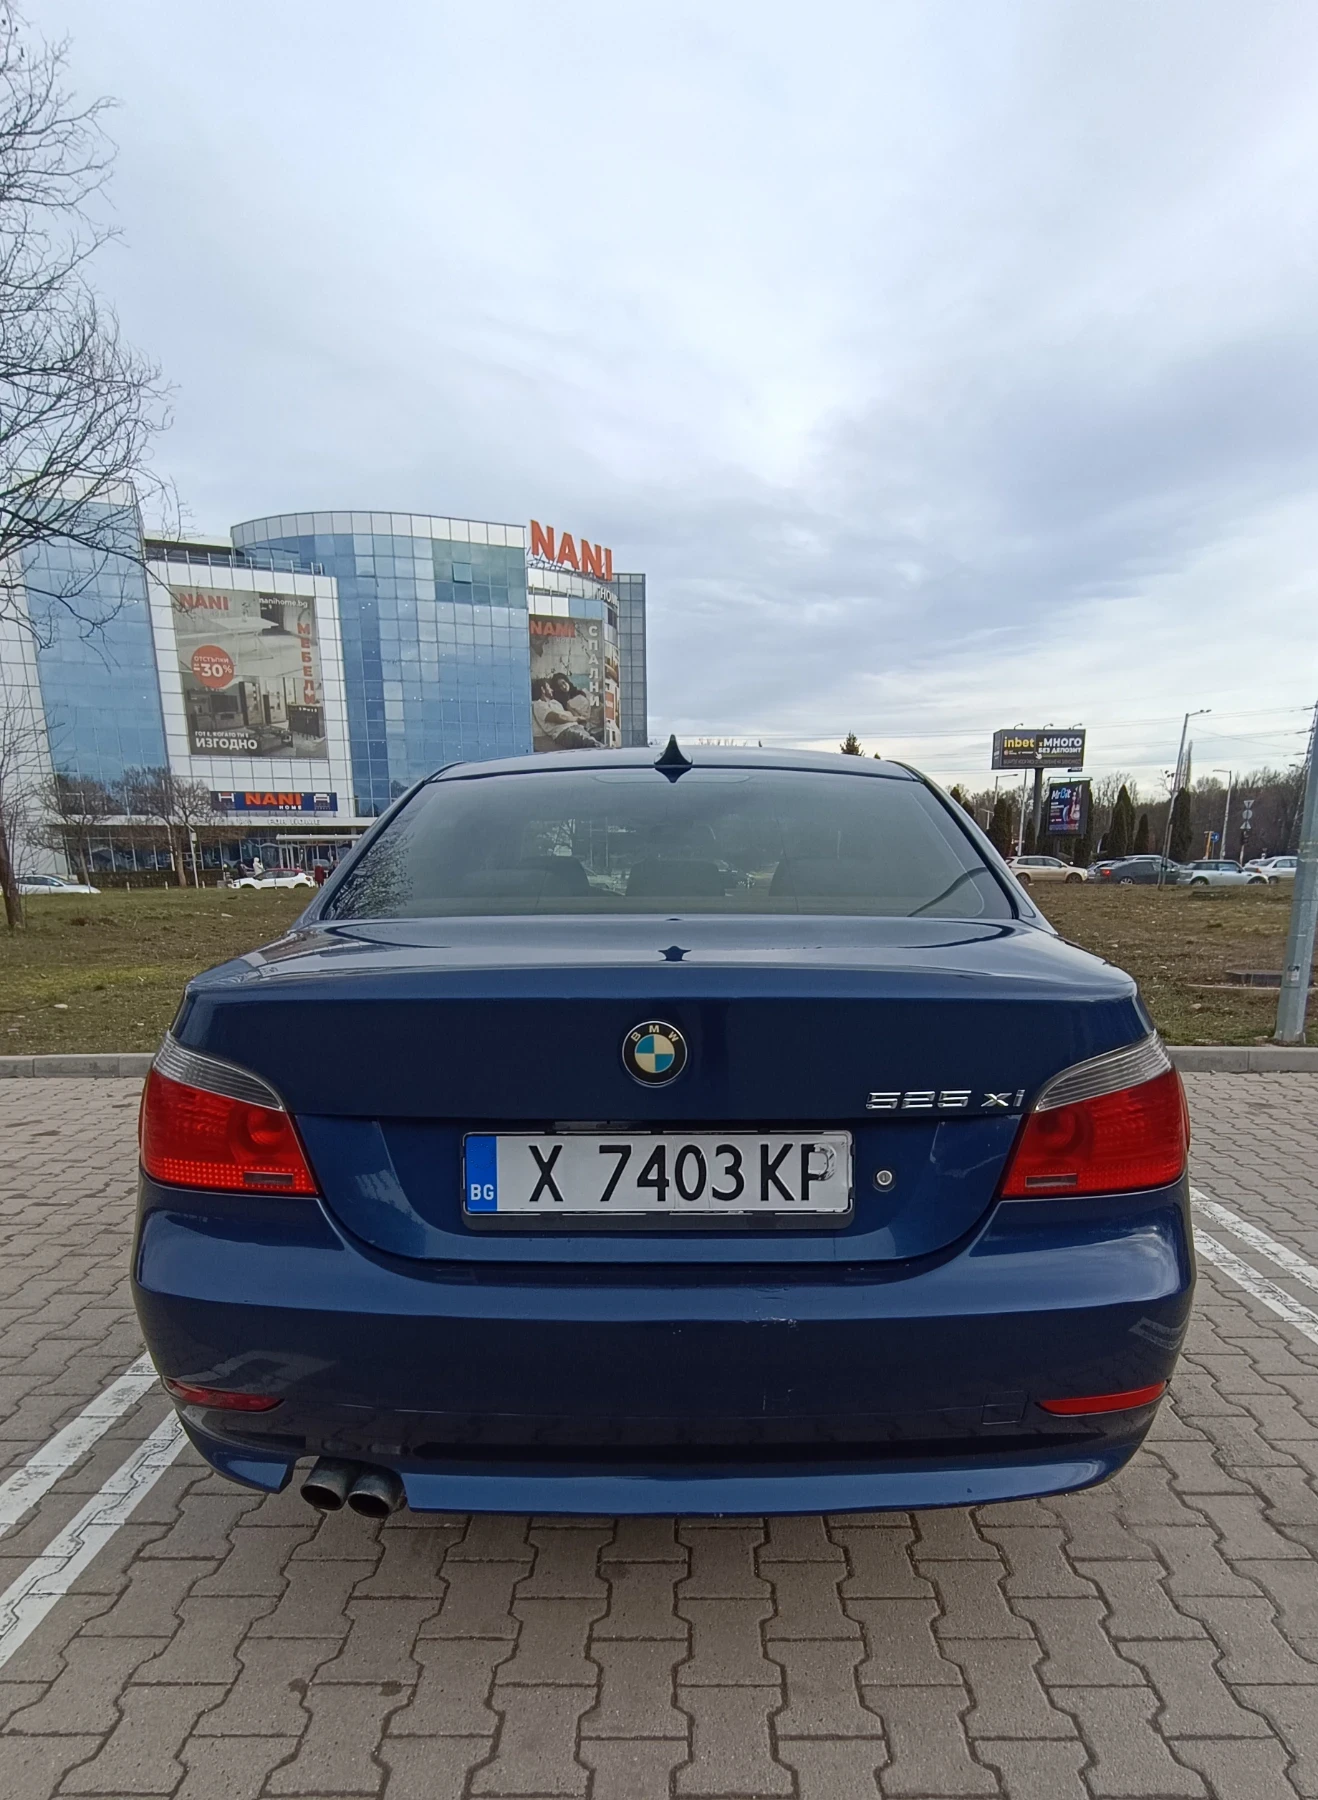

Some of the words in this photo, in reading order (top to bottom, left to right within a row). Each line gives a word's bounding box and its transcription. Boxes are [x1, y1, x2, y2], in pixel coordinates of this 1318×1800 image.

[531, 519, 613, 582] NANI
[179, 593, 229, 611] NANI
[259, 597, 308, 609] nanihome.bg
[530, 620, 576, 638] NANI
[588, 625, 601, 707] СПАЛНИ
[195, 737, 258, 751] ИЗГОДНО
[1004, 736, 1035, 748] inbet
[1044, 738, 1082, 747] МНОГО
[245, 792, 302, 805] NANI
[630, 1024, 680, 1042] BMW
[866, 1090, 972, 1109] 525
[981, 1089, 1025, 1107] xi
[528, 1144, 564, 1202] X
[599, 1143, 745, 1202] 7403
[470, 1183, 495, 1201] BG
